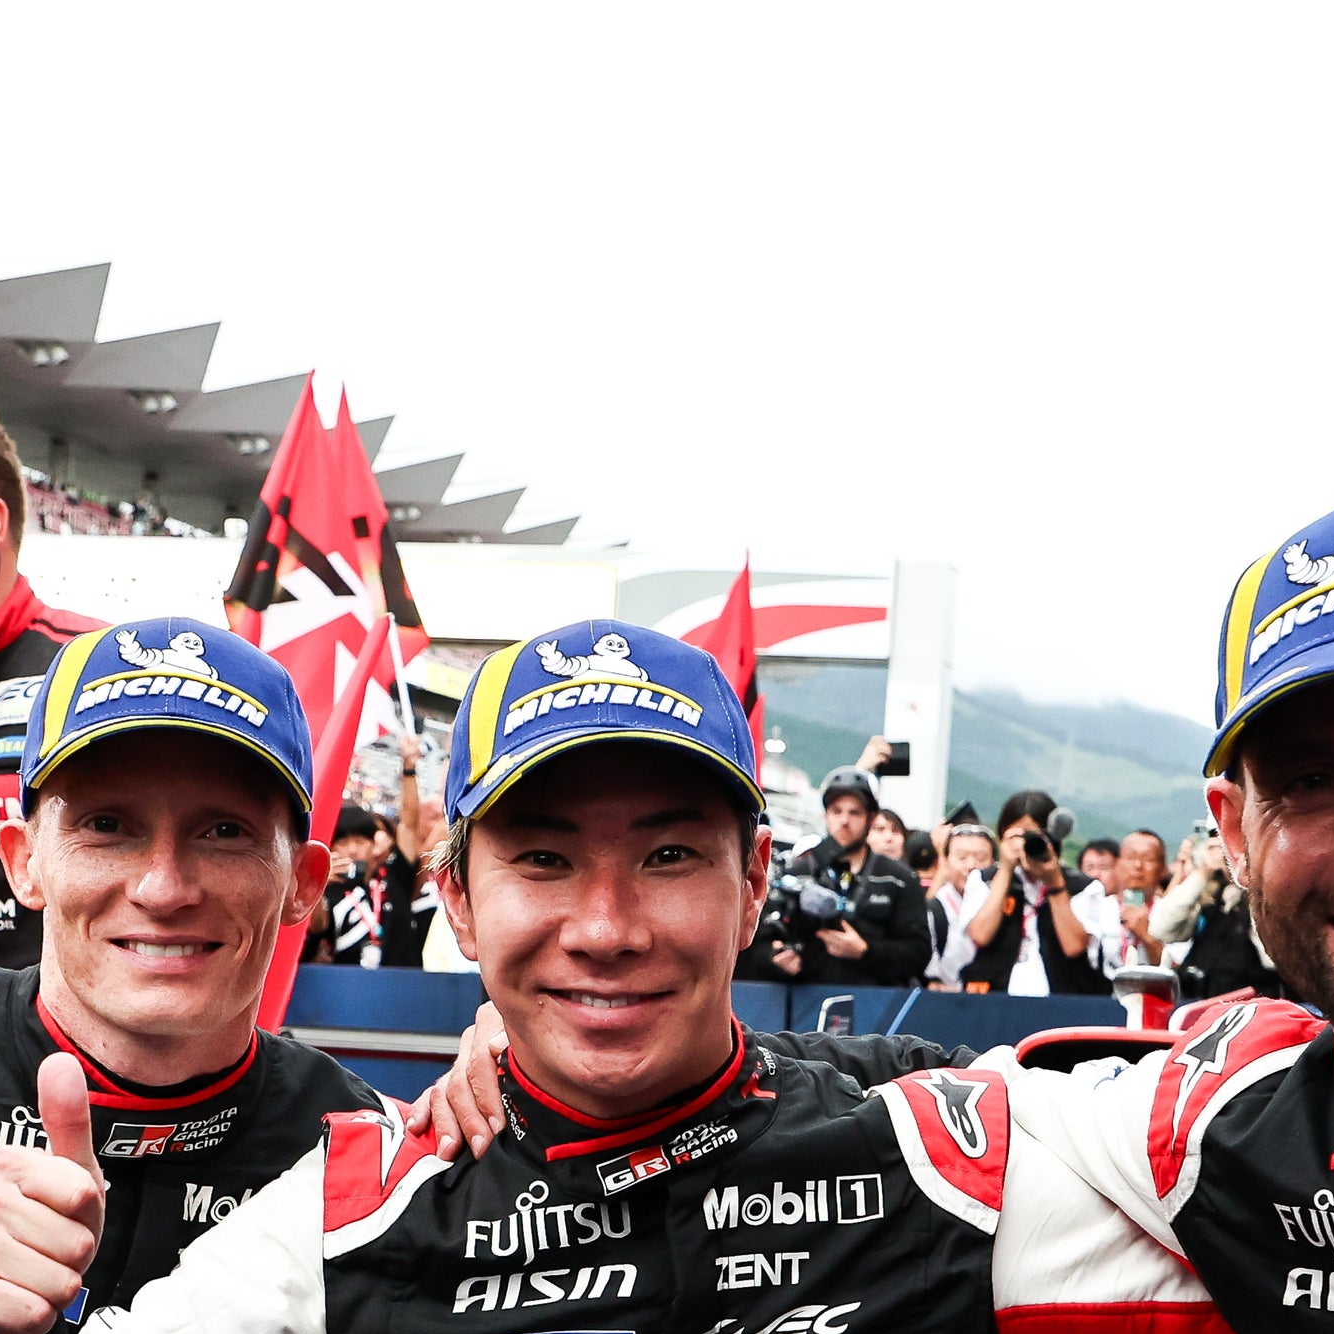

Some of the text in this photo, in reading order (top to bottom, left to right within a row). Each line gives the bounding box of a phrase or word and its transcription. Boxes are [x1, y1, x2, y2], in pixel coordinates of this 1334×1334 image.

[74, 676, 268, 728] MICHELIN
[503, 683, 704, 737] MICHELIN
[181, 1106, 238, 1132] TOYOTA
[674, 1127, 739, 1165] Racing
[604, 1157, 667, 1192] GR
[466, 1181, 631, 1266] FUJITSU
[703, 1180, 830, 1231] Mobil
[453, 1263, 638, 1313] AISIN
[715, 1251, 809, 1292] ZENT
